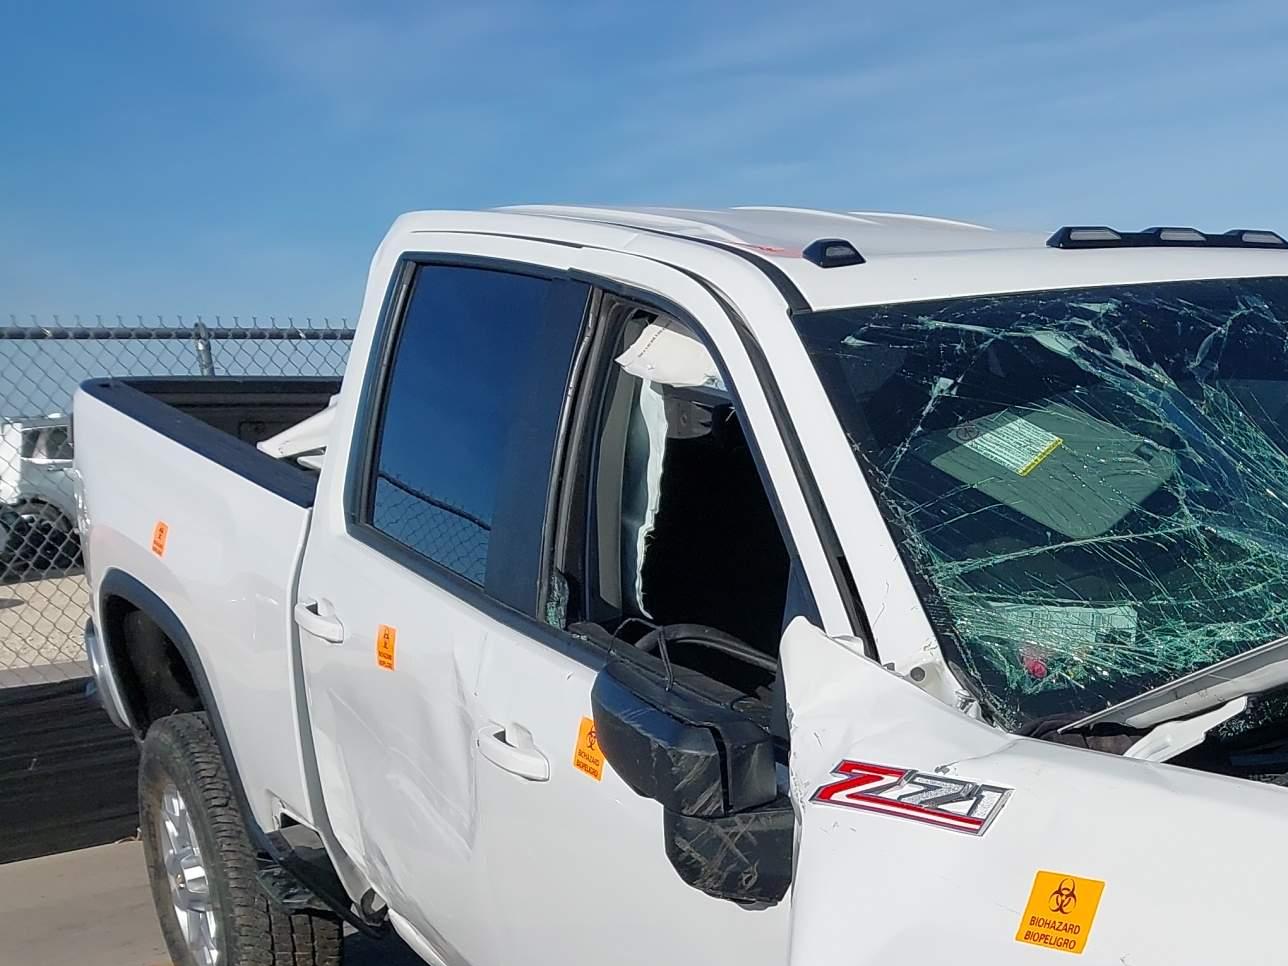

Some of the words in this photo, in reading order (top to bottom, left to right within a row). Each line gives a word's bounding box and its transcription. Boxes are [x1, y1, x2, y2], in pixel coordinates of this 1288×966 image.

[809, 758, 1016, 837] Z71
[1029, 915, 1081, 935] BIOHAZARD
[1023, 930, 1077, 950] BIOPELIGRO
